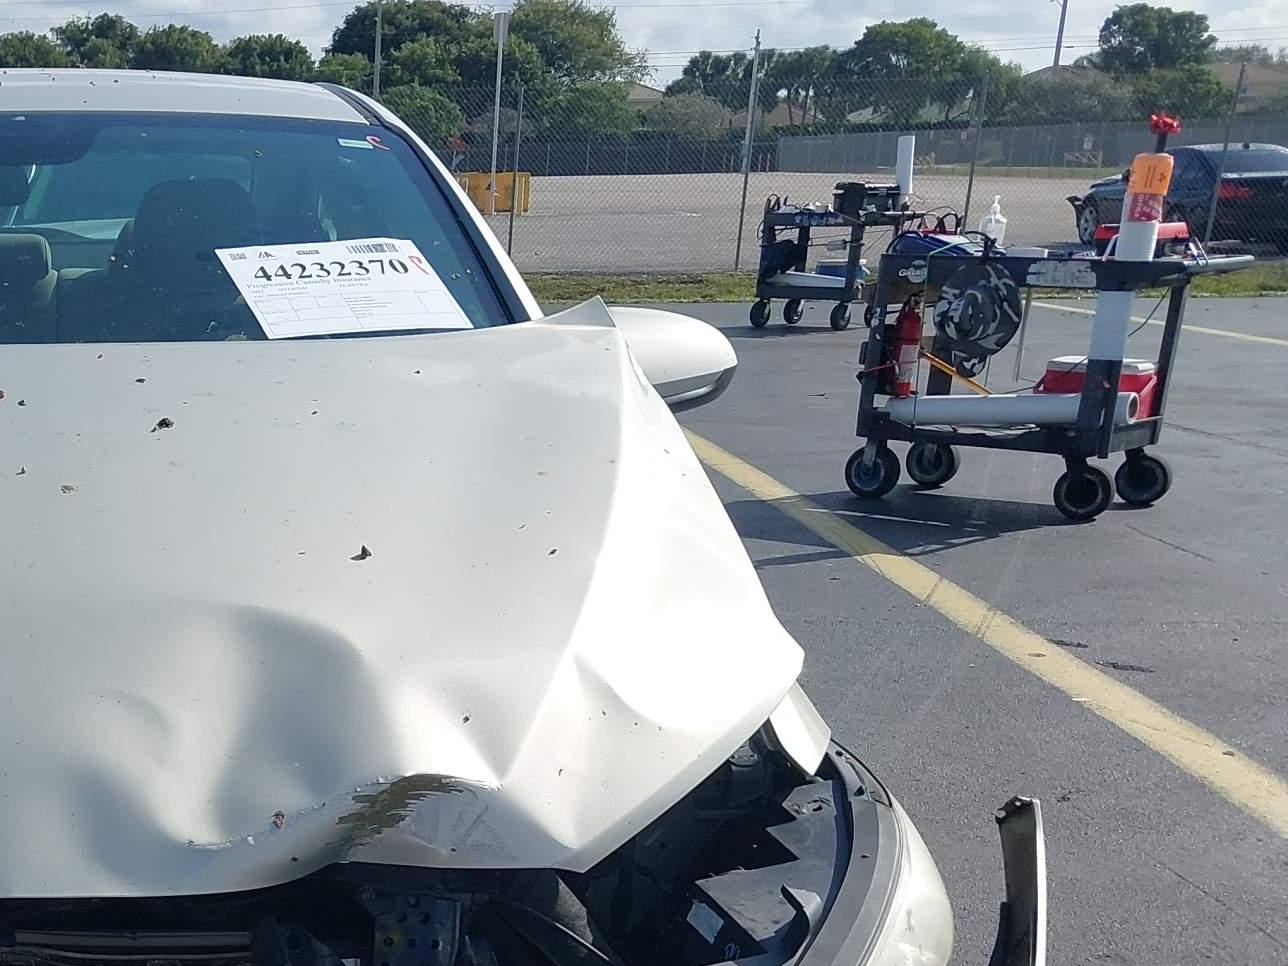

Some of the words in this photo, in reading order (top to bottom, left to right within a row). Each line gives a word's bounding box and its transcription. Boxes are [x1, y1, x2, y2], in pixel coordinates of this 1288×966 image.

[254, 259, 409, 281] 44232370
[246, 280, 295, 290] Progressive
[332, 275, 372, 284] Insurance
